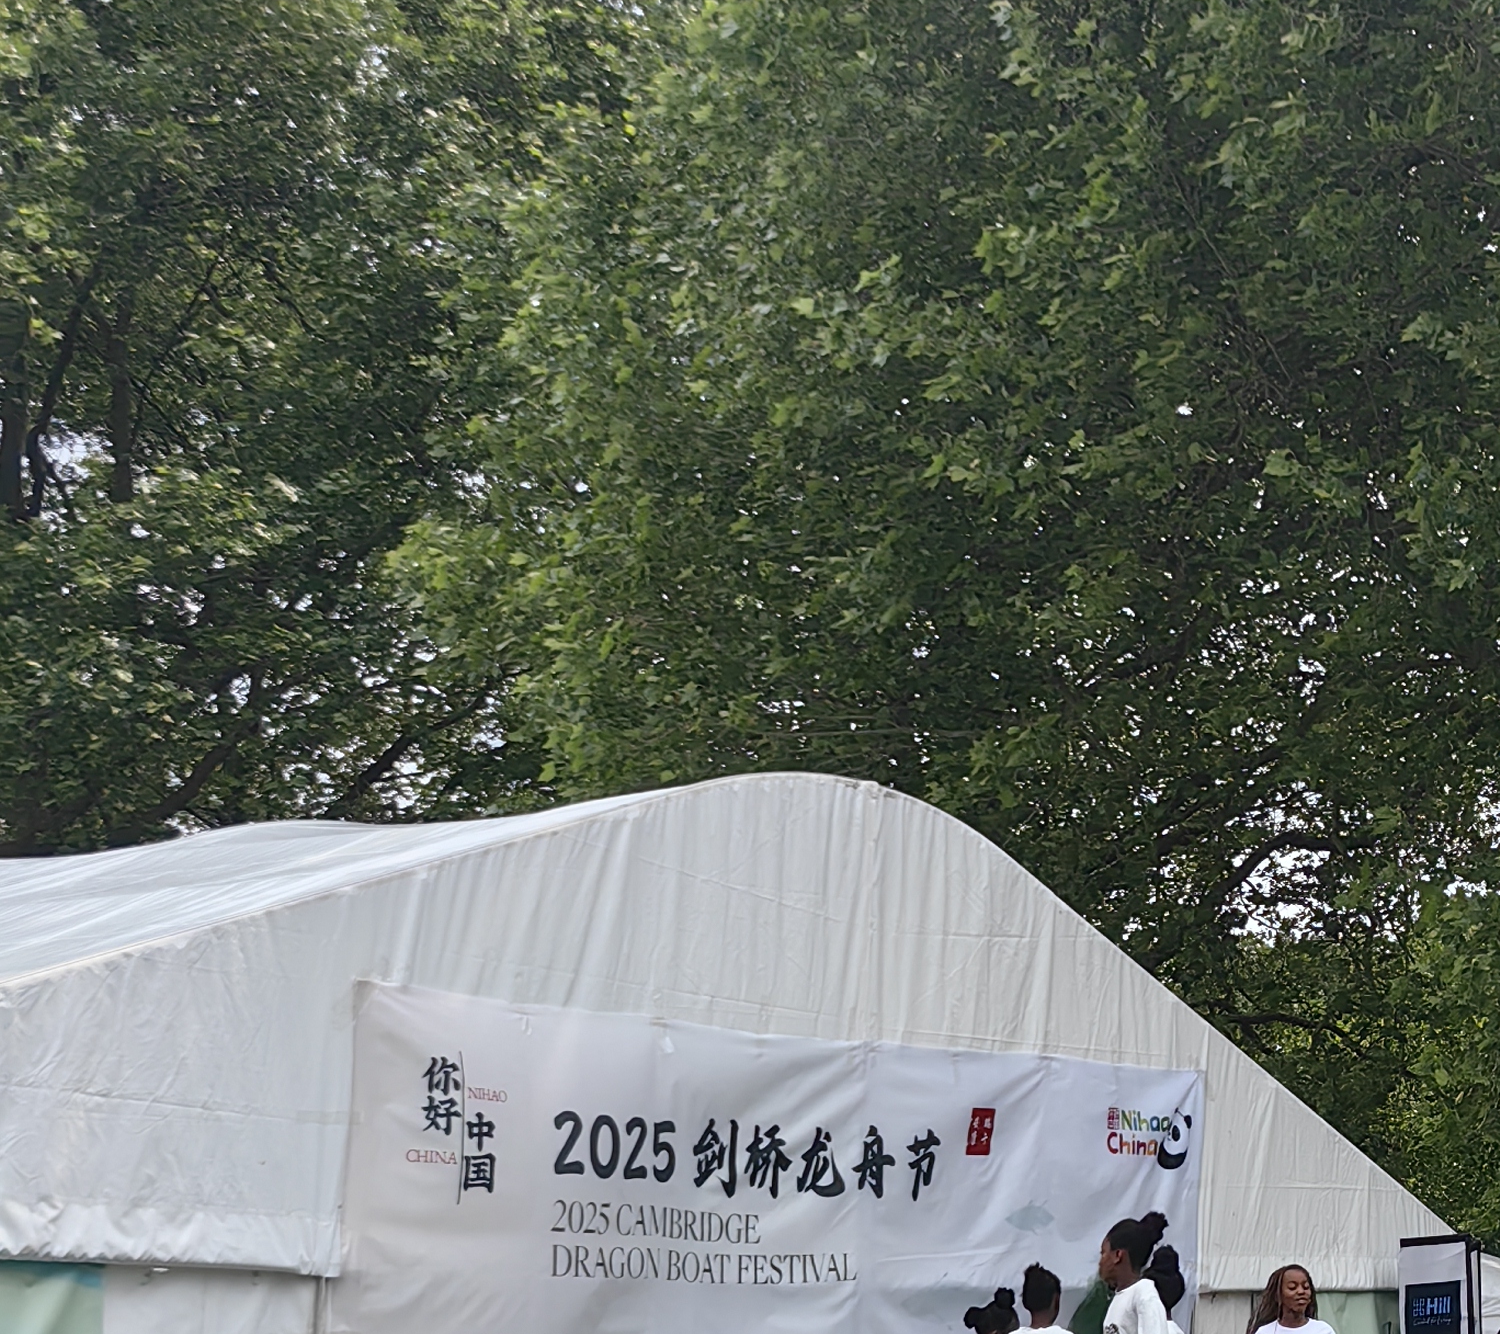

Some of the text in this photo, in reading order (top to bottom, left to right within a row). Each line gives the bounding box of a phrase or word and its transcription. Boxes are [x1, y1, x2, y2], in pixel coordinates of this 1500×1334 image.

[421, 1056, 462, 1136] 你好
[467, 1087, 508, 1103] NIHAO
[405, 1148, 458, 1165] CHINA
[463, 1111, 497, 1194] 中国
[554, 1110, 676, 1184] 2025
[692, 1118, 941, 1202] 剑桥龙舟节
[1107, 1131, 1157, 1156] China
[550, 1199, 762, 1244] 2025 CAMBRIDGE
[551, 1244, 859, 1285] DRAGON BOAT FESTIVAL
